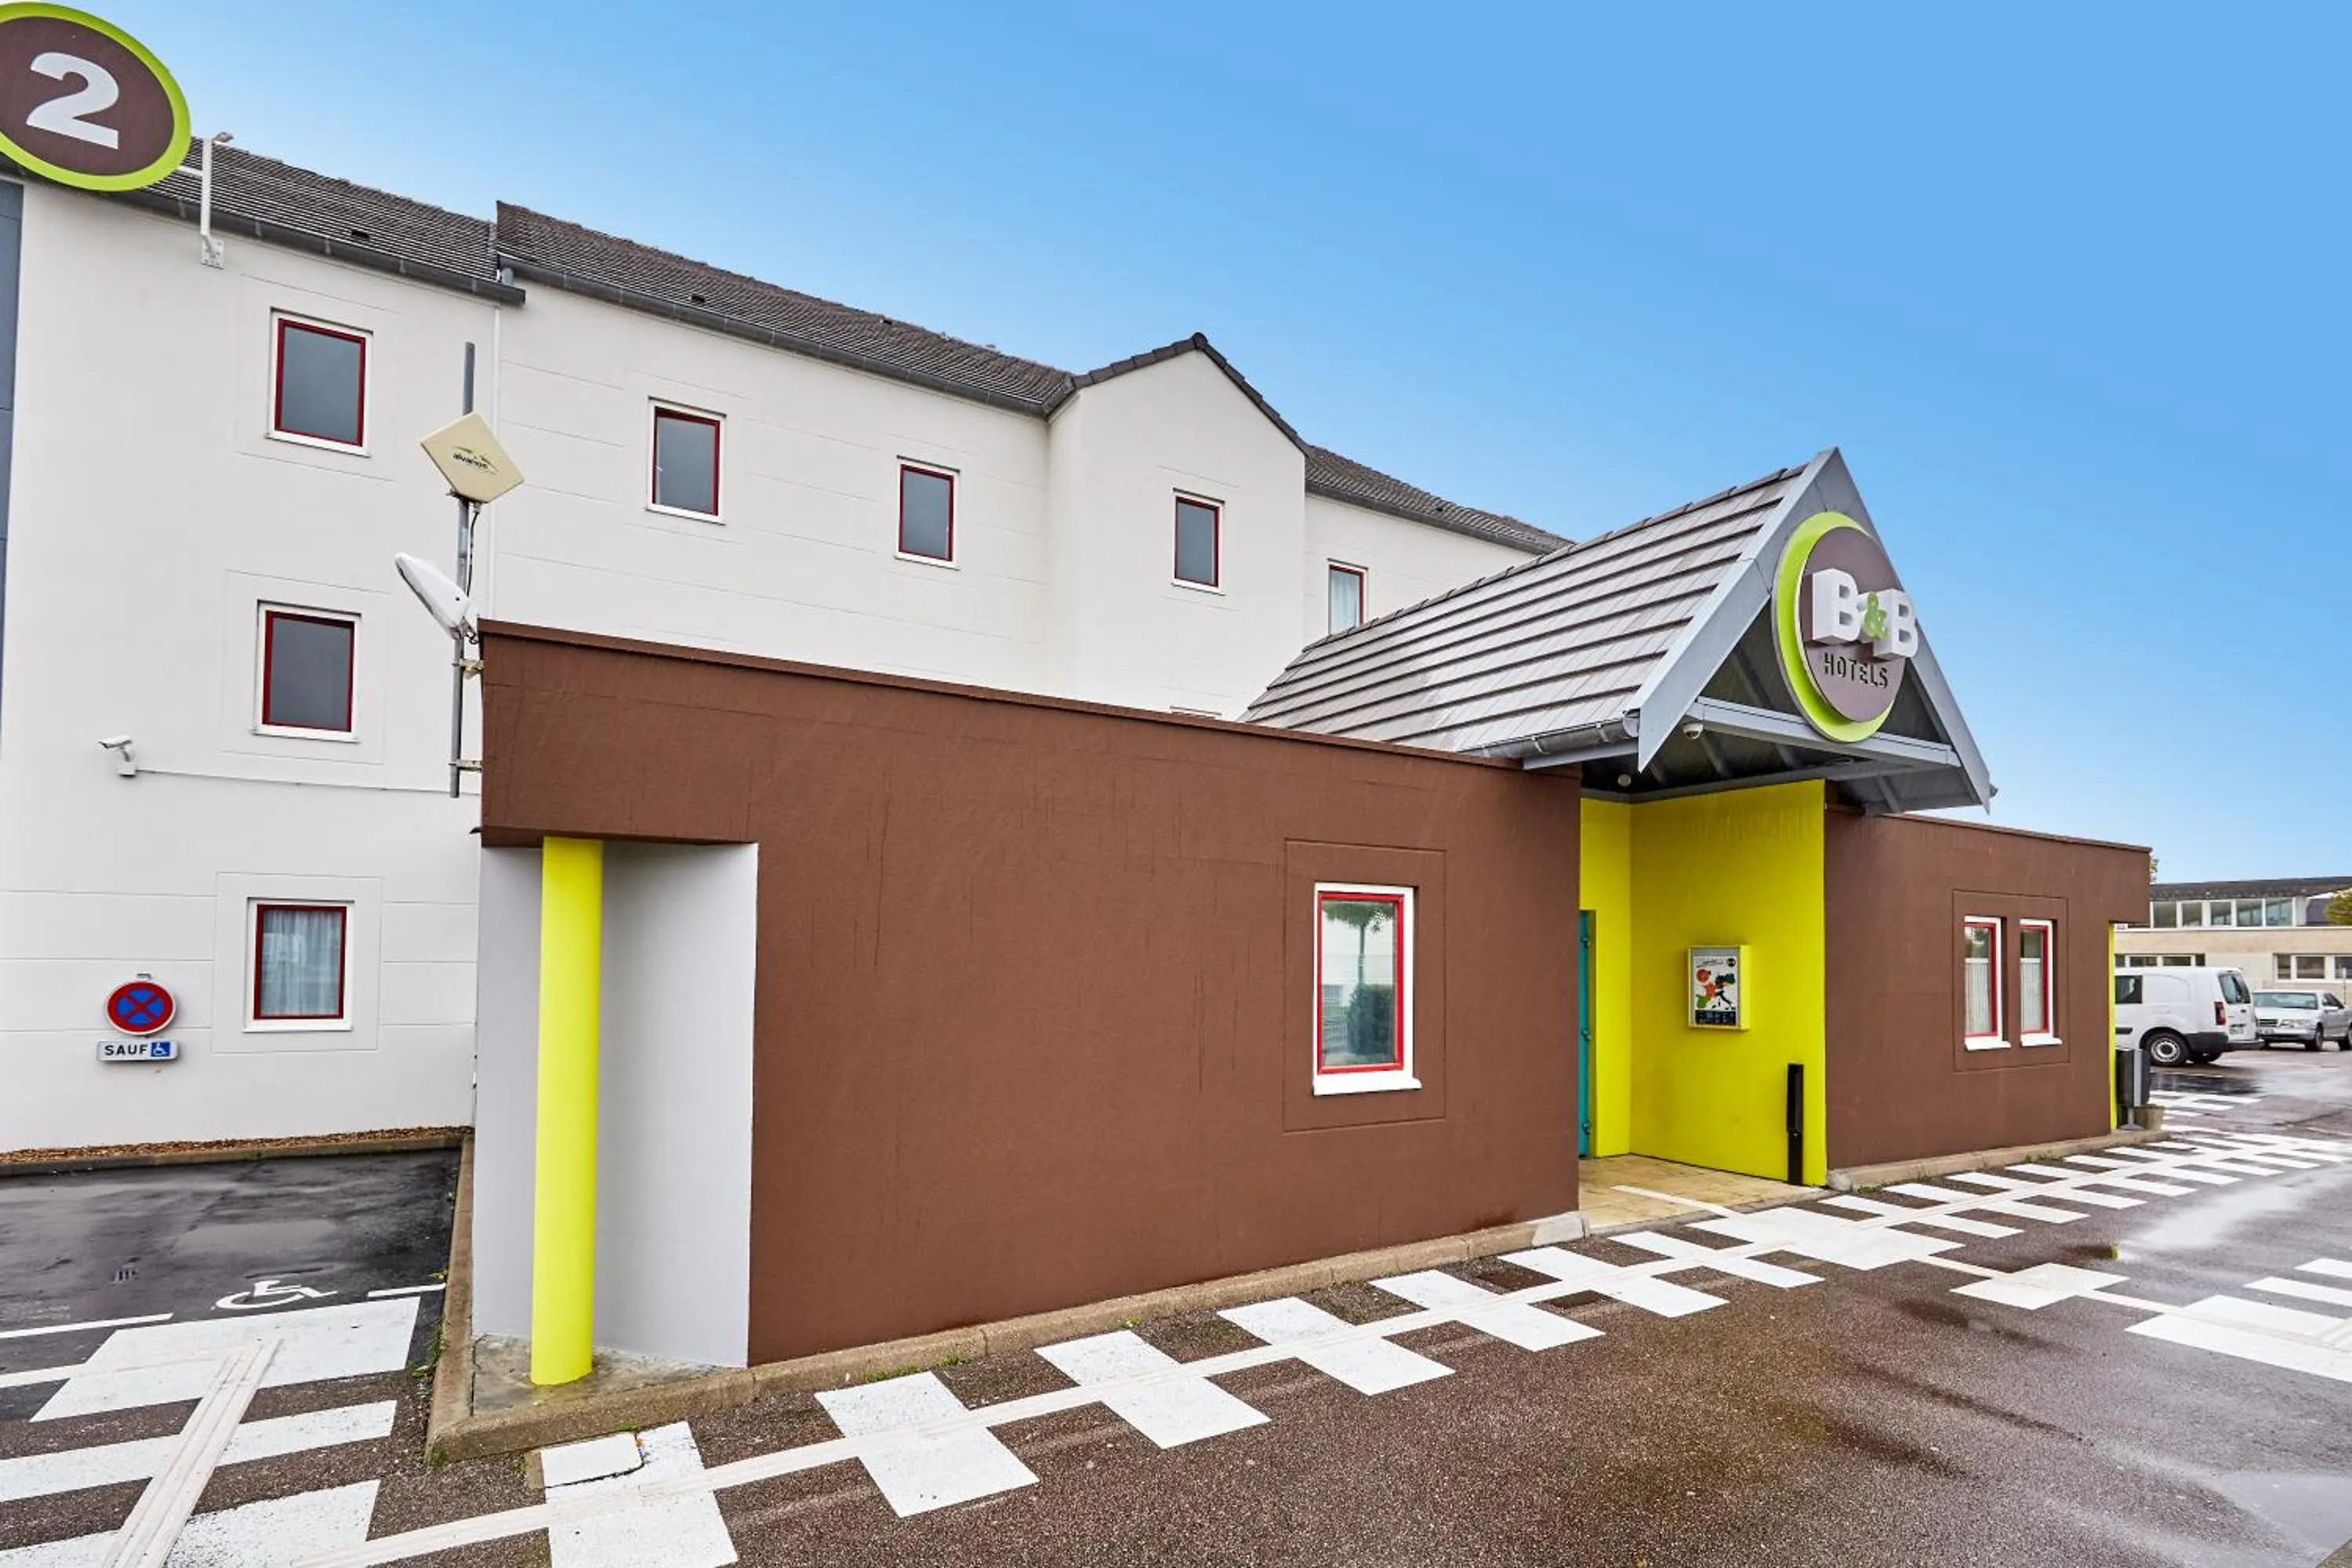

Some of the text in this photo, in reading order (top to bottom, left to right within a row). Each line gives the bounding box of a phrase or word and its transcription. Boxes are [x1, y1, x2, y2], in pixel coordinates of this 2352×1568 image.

[26, 52, 120, 150] 2
[1811, 568, 1919, 659] B&B
[1824, 652, 1888, 688] HOTELS
[104, 1044, 148, 1055] SAUF
